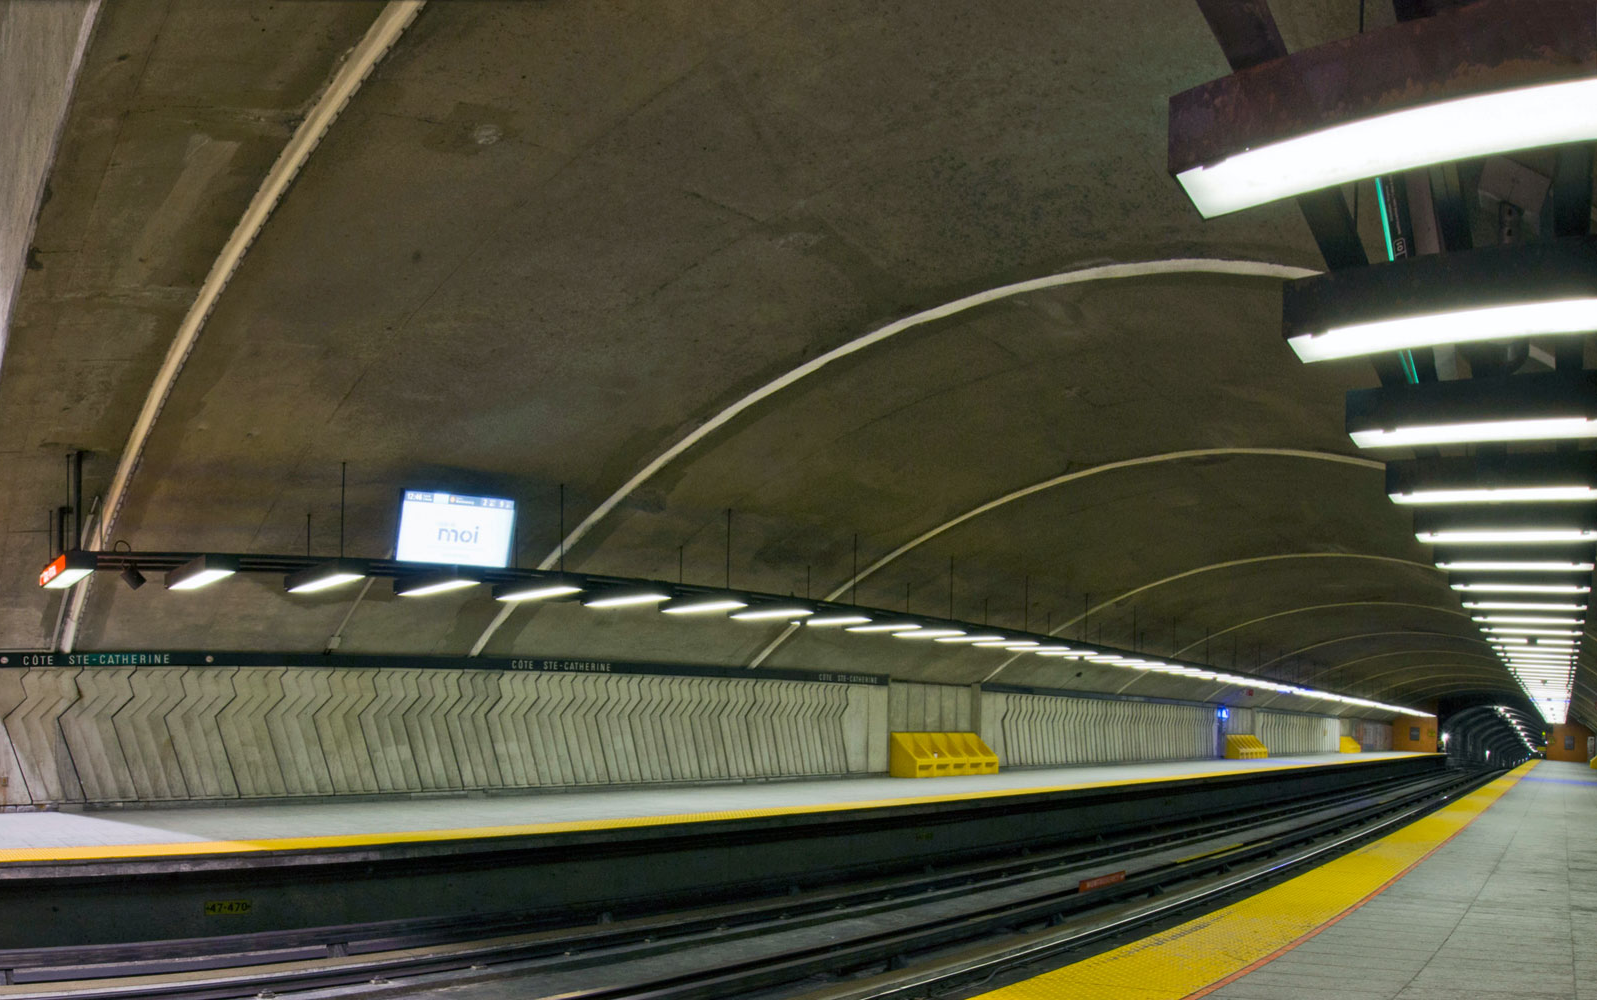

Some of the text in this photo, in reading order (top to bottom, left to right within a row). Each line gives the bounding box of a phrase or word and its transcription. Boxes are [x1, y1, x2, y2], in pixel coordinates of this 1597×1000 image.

[438, 526, 479, 544] moi
[23, 653, 170, 666] CÔTE STE-CATHERINE
[543, 661, 611, 672] STE-CATHERINE
